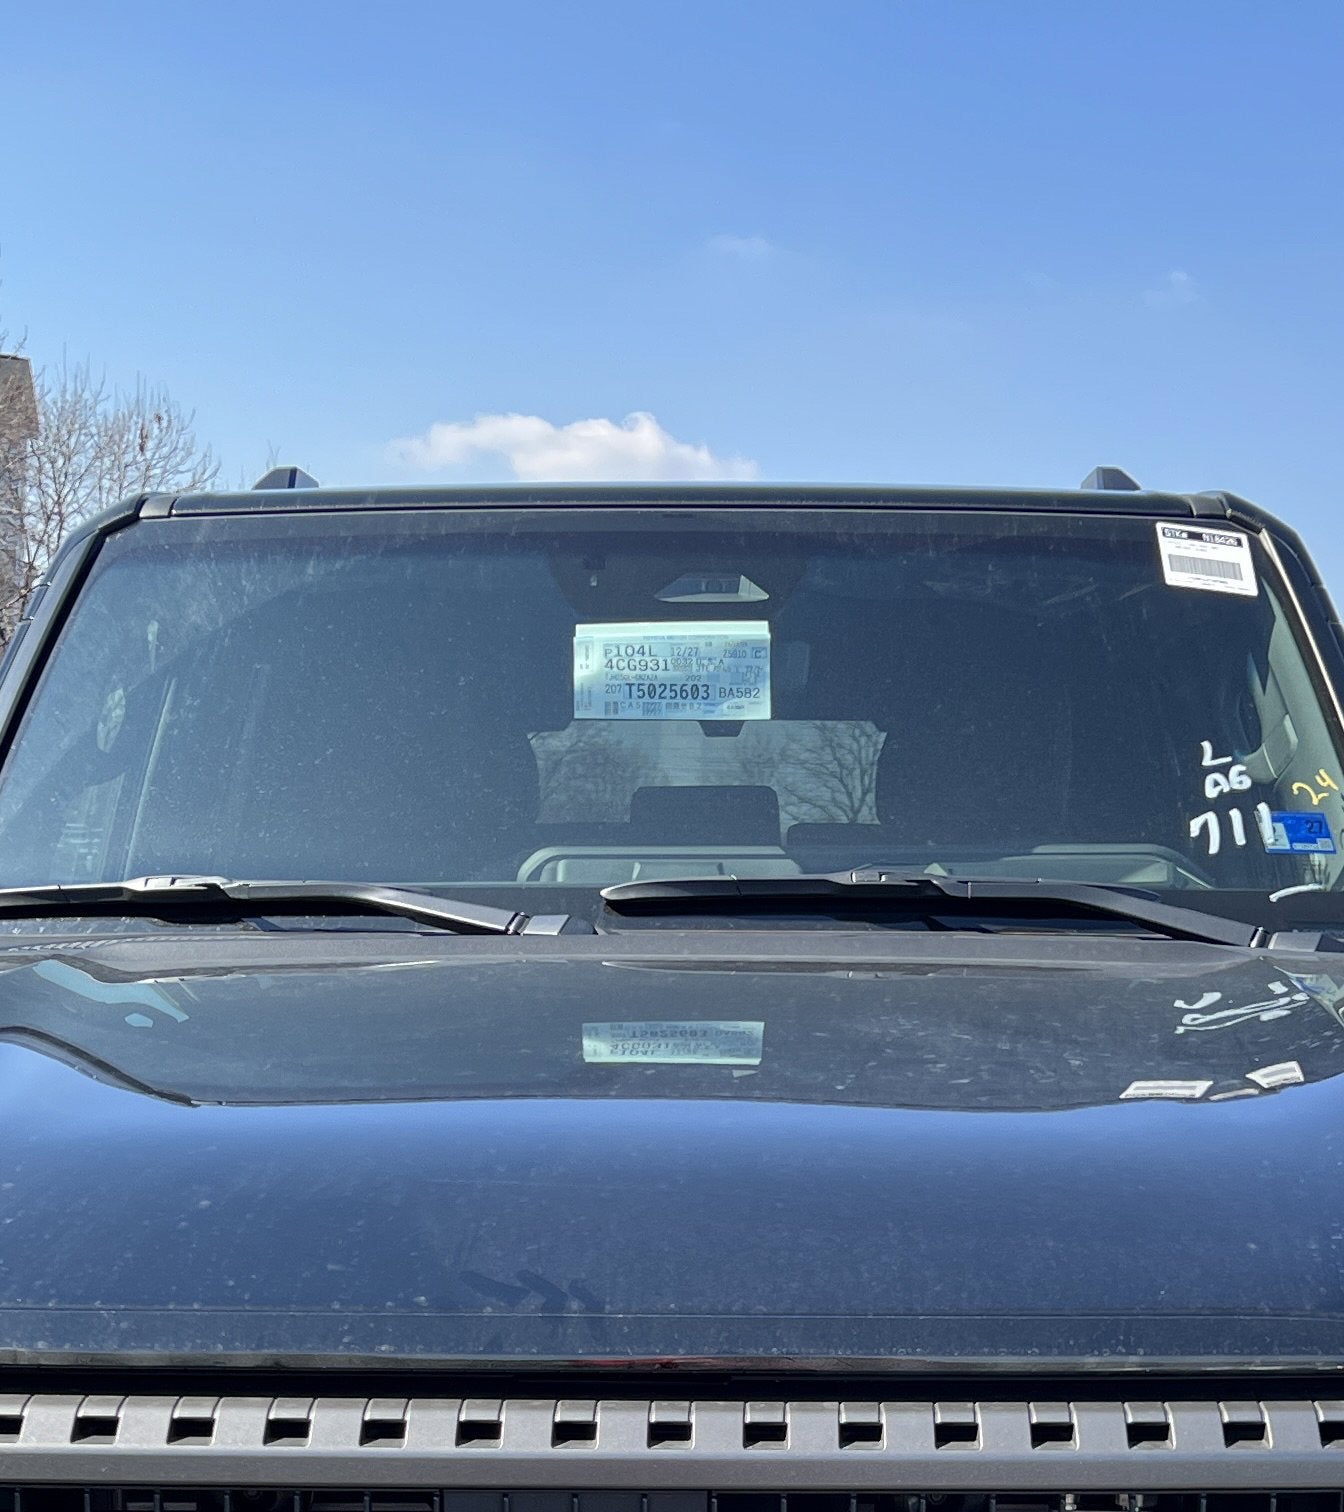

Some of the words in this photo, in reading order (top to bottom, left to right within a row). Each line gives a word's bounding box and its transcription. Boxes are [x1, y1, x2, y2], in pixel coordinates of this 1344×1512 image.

[603, 658, 670, 672] 4CG931
[604, 683, 623, 695] 207
[625, 682, 711, 701] T5025603
